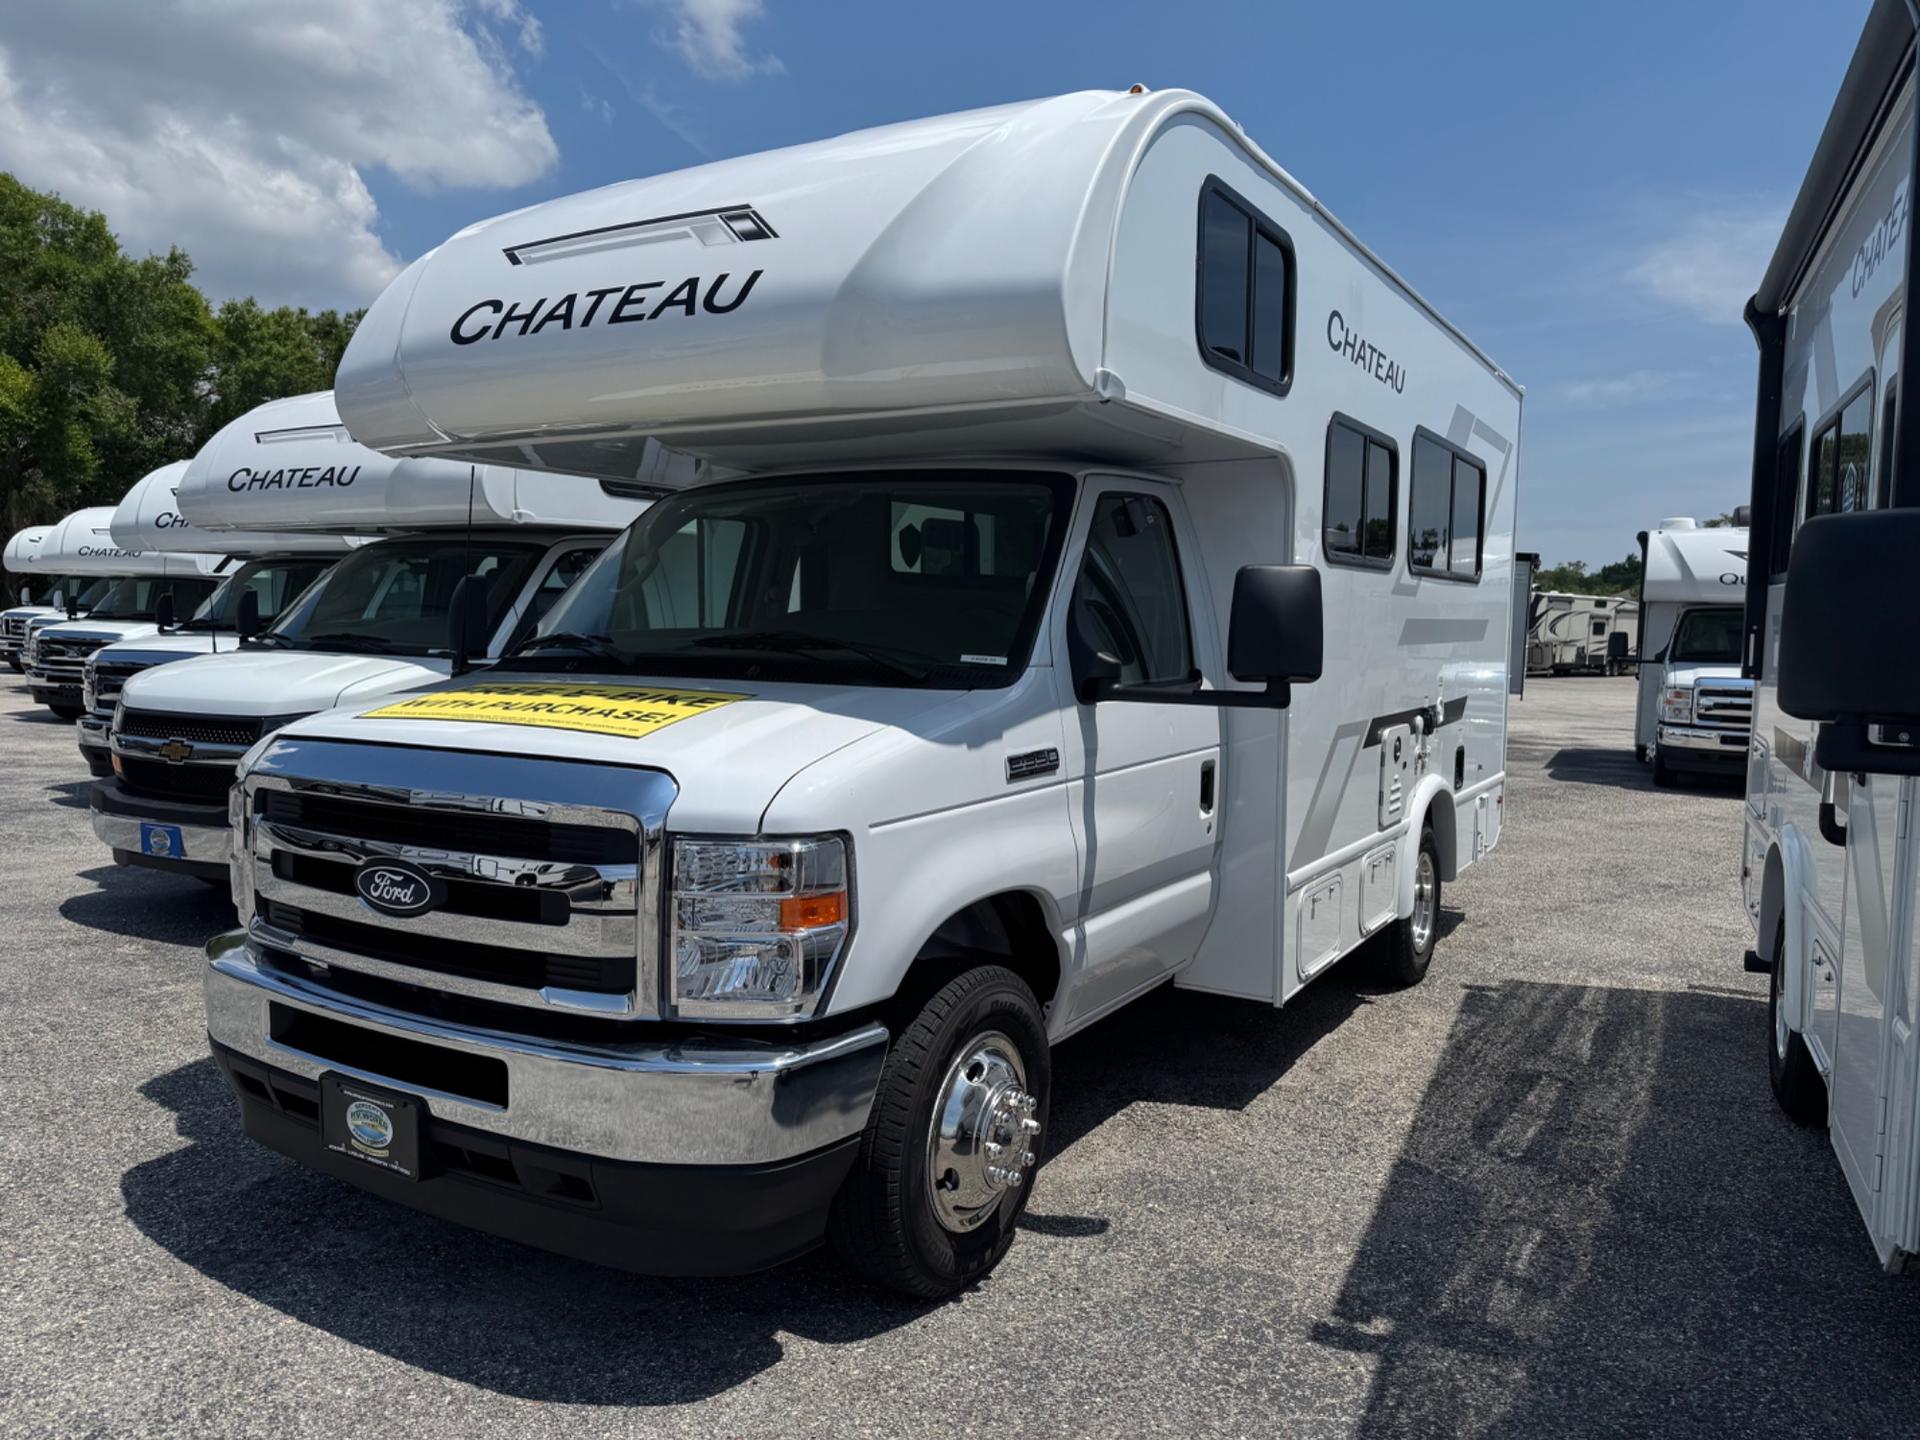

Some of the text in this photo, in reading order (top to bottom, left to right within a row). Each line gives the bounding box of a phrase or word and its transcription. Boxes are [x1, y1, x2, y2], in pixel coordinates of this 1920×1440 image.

[450, 269, 764, 346] CHATEAU
[1327, 310, 1406, 394] CHATEAU
[227, 465, 361, 492] CHATEAU
[401, 699, 486, 709] WITH
[479, 701, 678, 724] PURCHASE!
[370, 871, 415, 903] Ford
